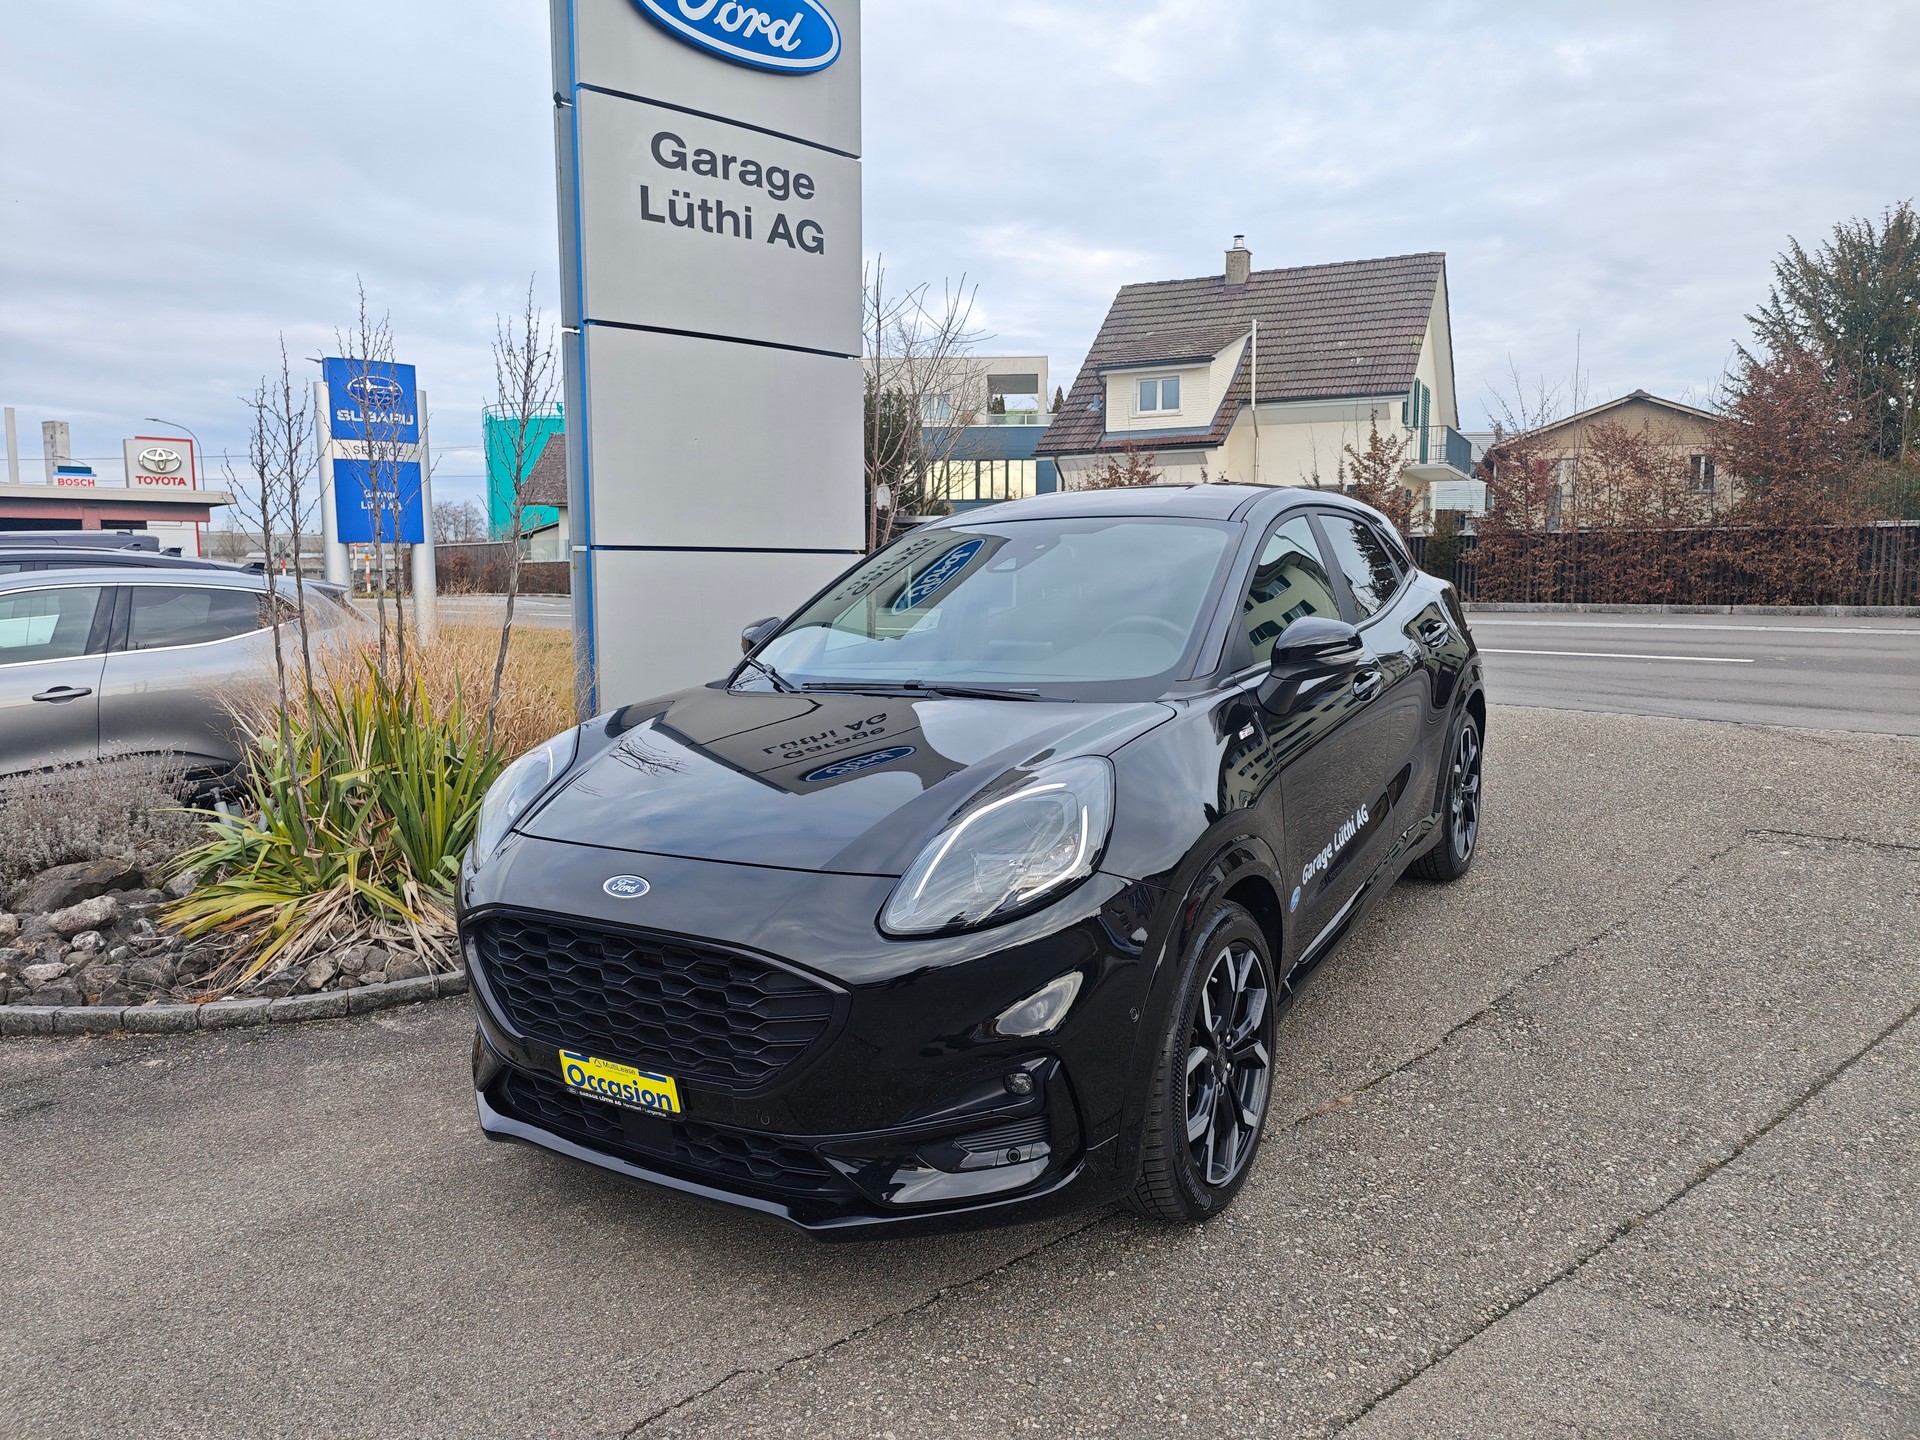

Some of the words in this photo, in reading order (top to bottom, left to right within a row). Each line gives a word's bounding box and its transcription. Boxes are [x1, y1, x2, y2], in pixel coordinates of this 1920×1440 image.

[650, 131, 815, 201] Garage
[640, 184, 752, 240] Lüthi
[766, 213, 825, 256] AG
[353, 445, 404, 457] SERCE
[57, 478, 95, 487] BOSCH
[135, 475, 187, 486] TOYOTA
[1302, 842, 1333, 885] Garage
[1333, 814, 1357, 852] Lüthi
[1356, 803, 1370, 829] AG
[611, 878, 640, 893] Ford
[567, 1064, 673, 1111] Occasion
